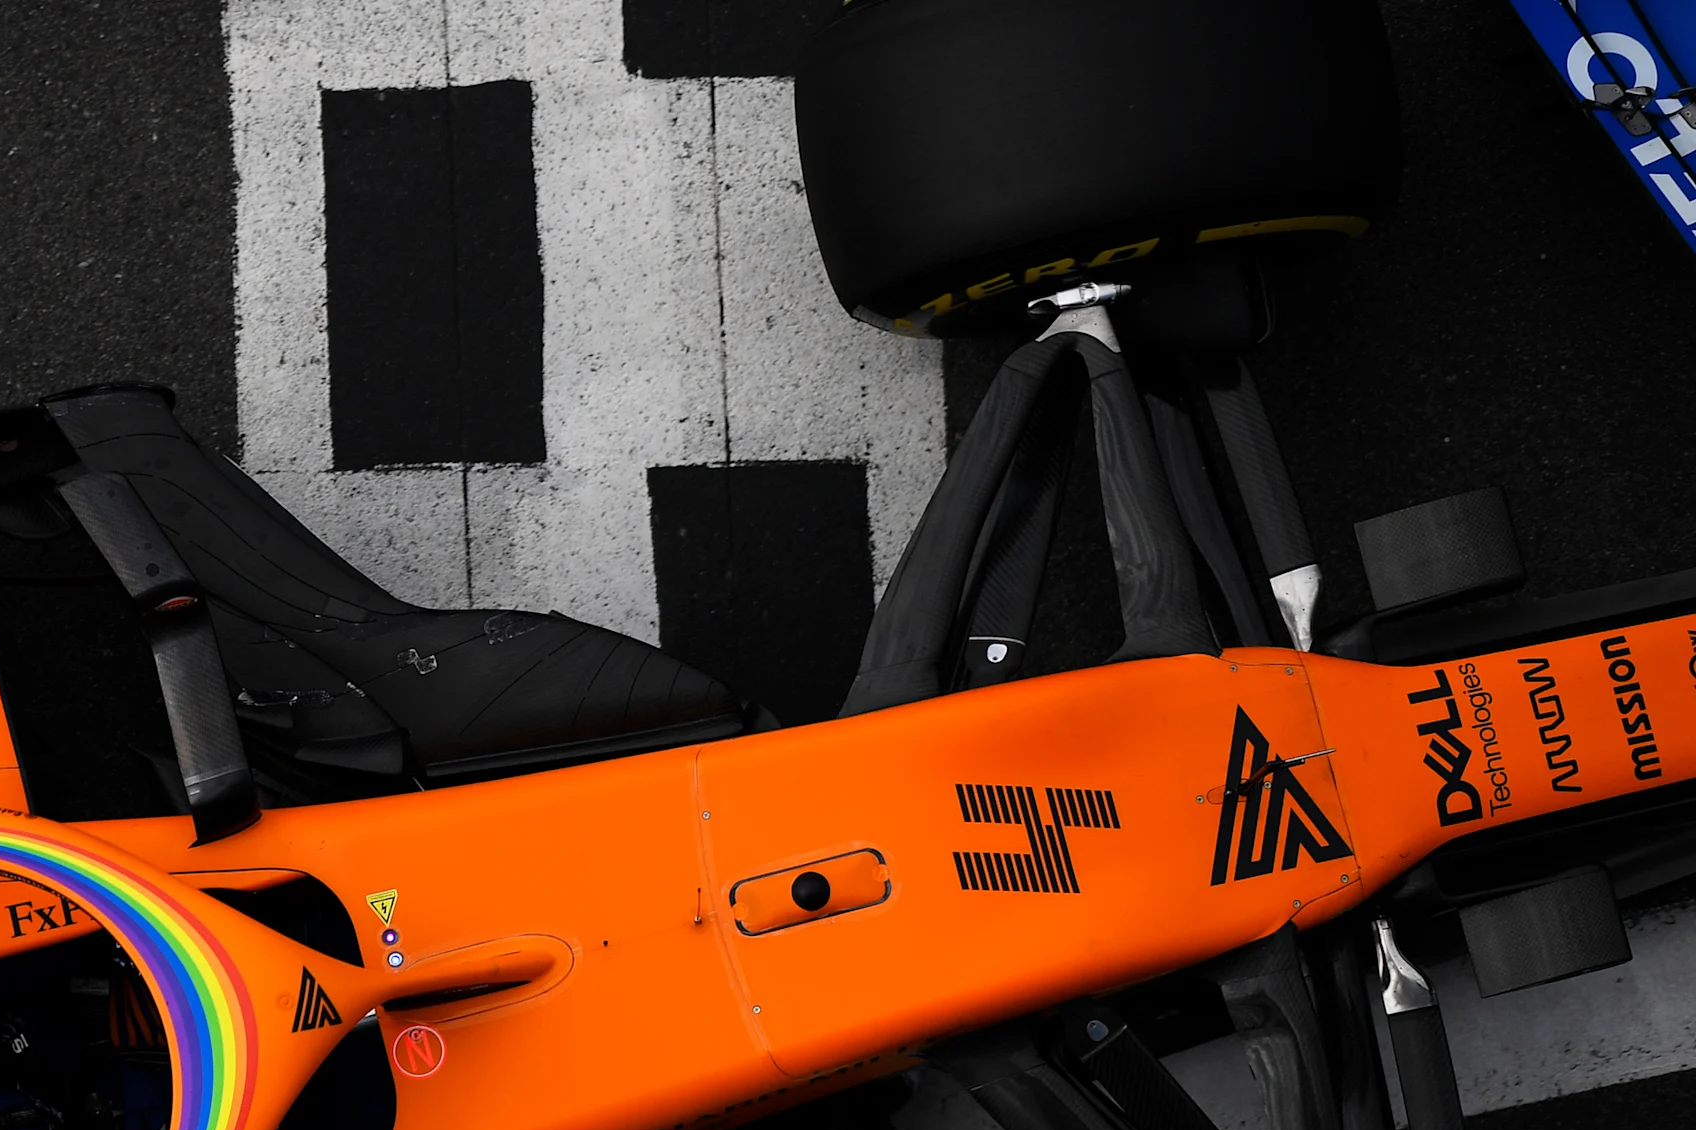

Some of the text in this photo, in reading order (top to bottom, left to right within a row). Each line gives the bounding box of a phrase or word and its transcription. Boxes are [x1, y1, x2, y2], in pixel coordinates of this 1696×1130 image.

[920, 238, 1160, 314] ZERO
[1407, 669, 1484, 827] DELL
[1458, 662, 1513, 817] Technologies
